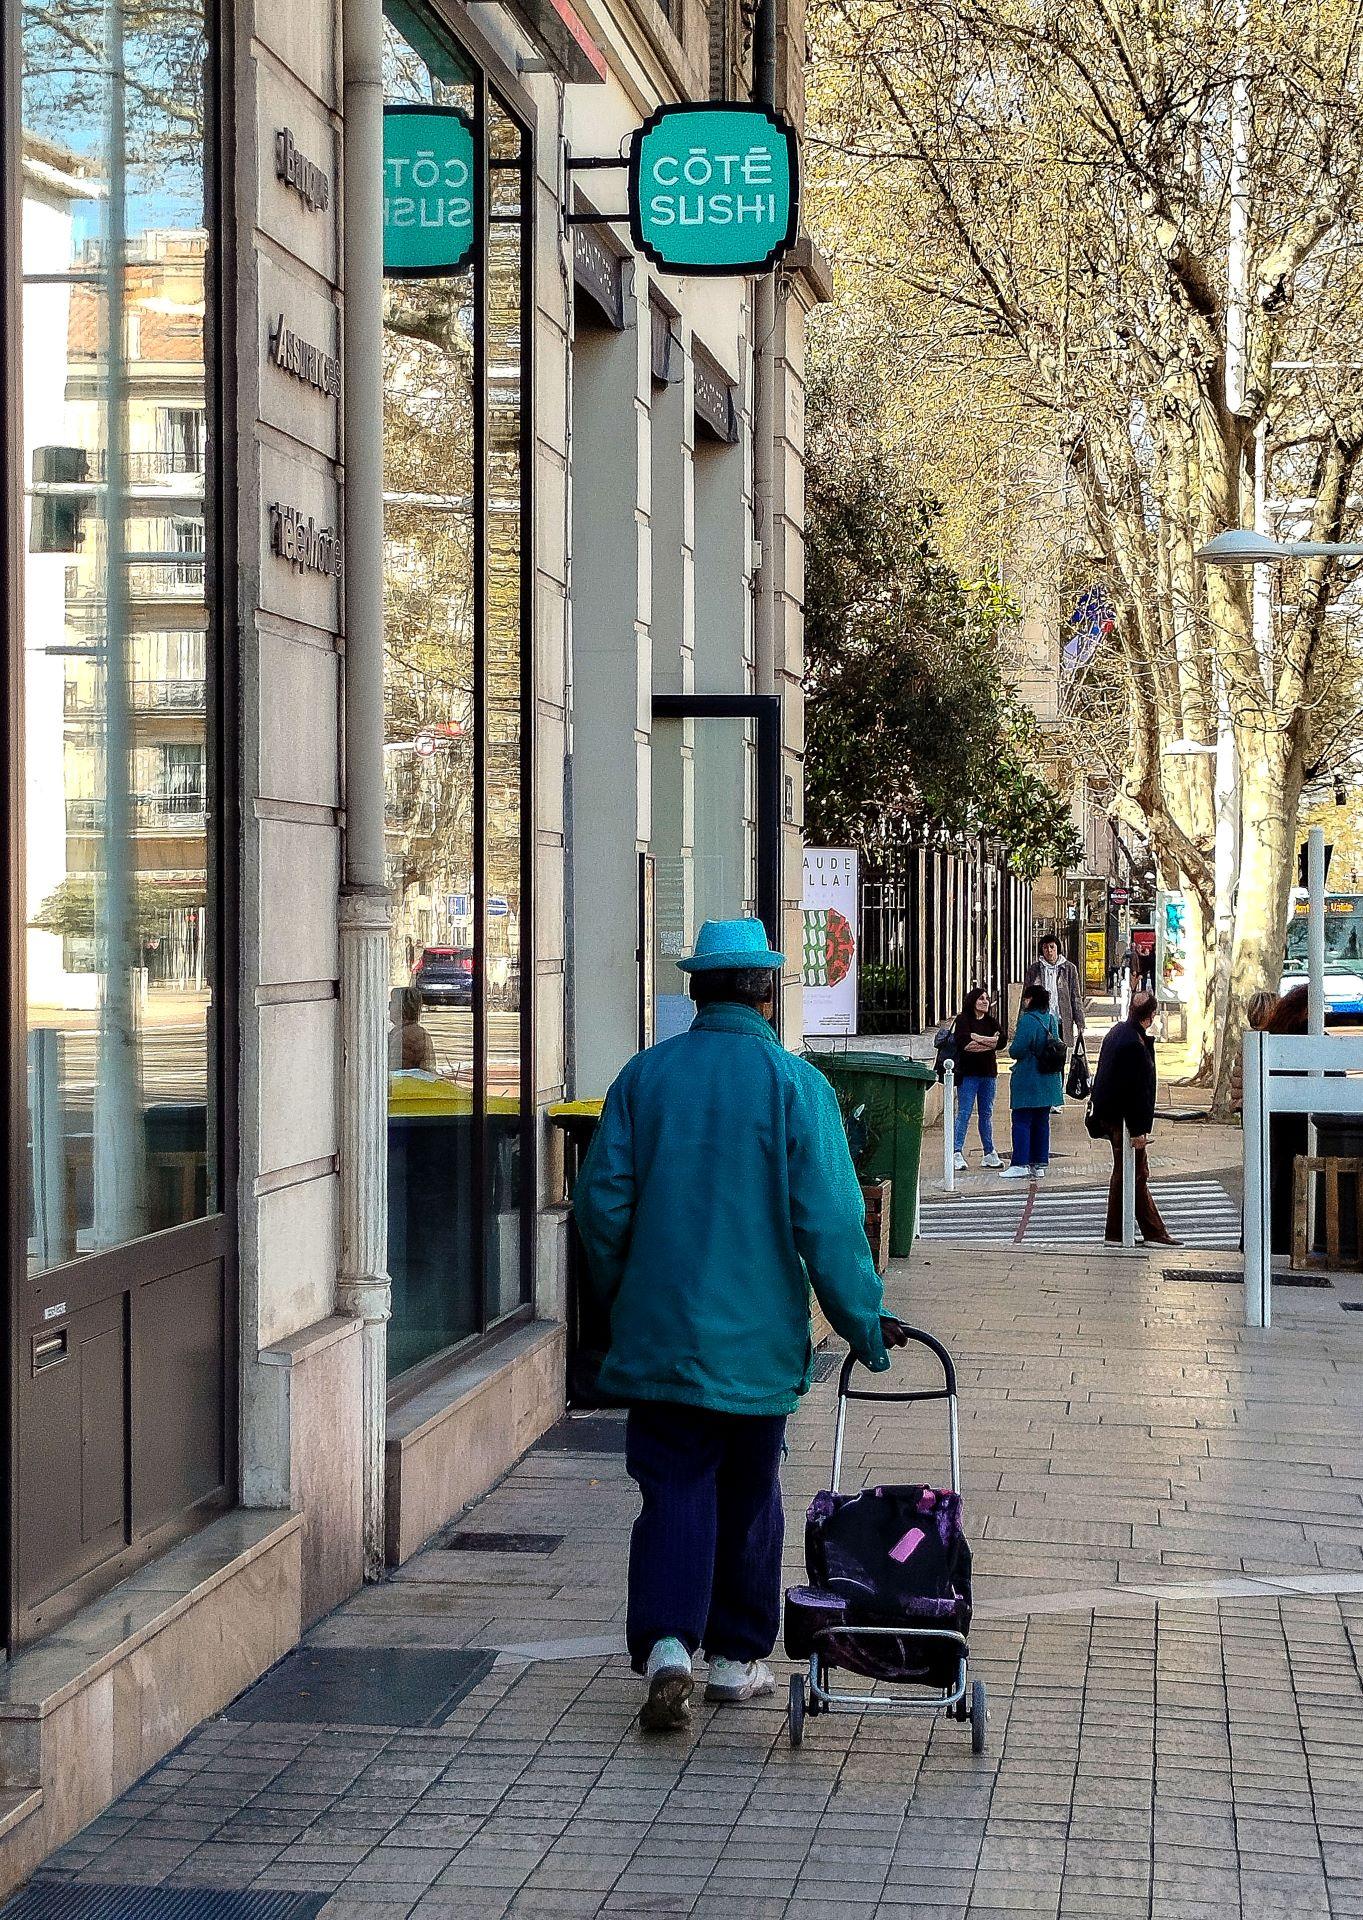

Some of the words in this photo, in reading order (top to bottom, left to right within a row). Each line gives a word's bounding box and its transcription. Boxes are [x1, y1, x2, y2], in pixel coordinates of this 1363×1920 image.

[650, 194, 776, 227] SUSHI
[276, 313, 341, 397] Assurances
[803, 857, 851, 870] AUDE
[809, 874, 852, 887] LLAT
